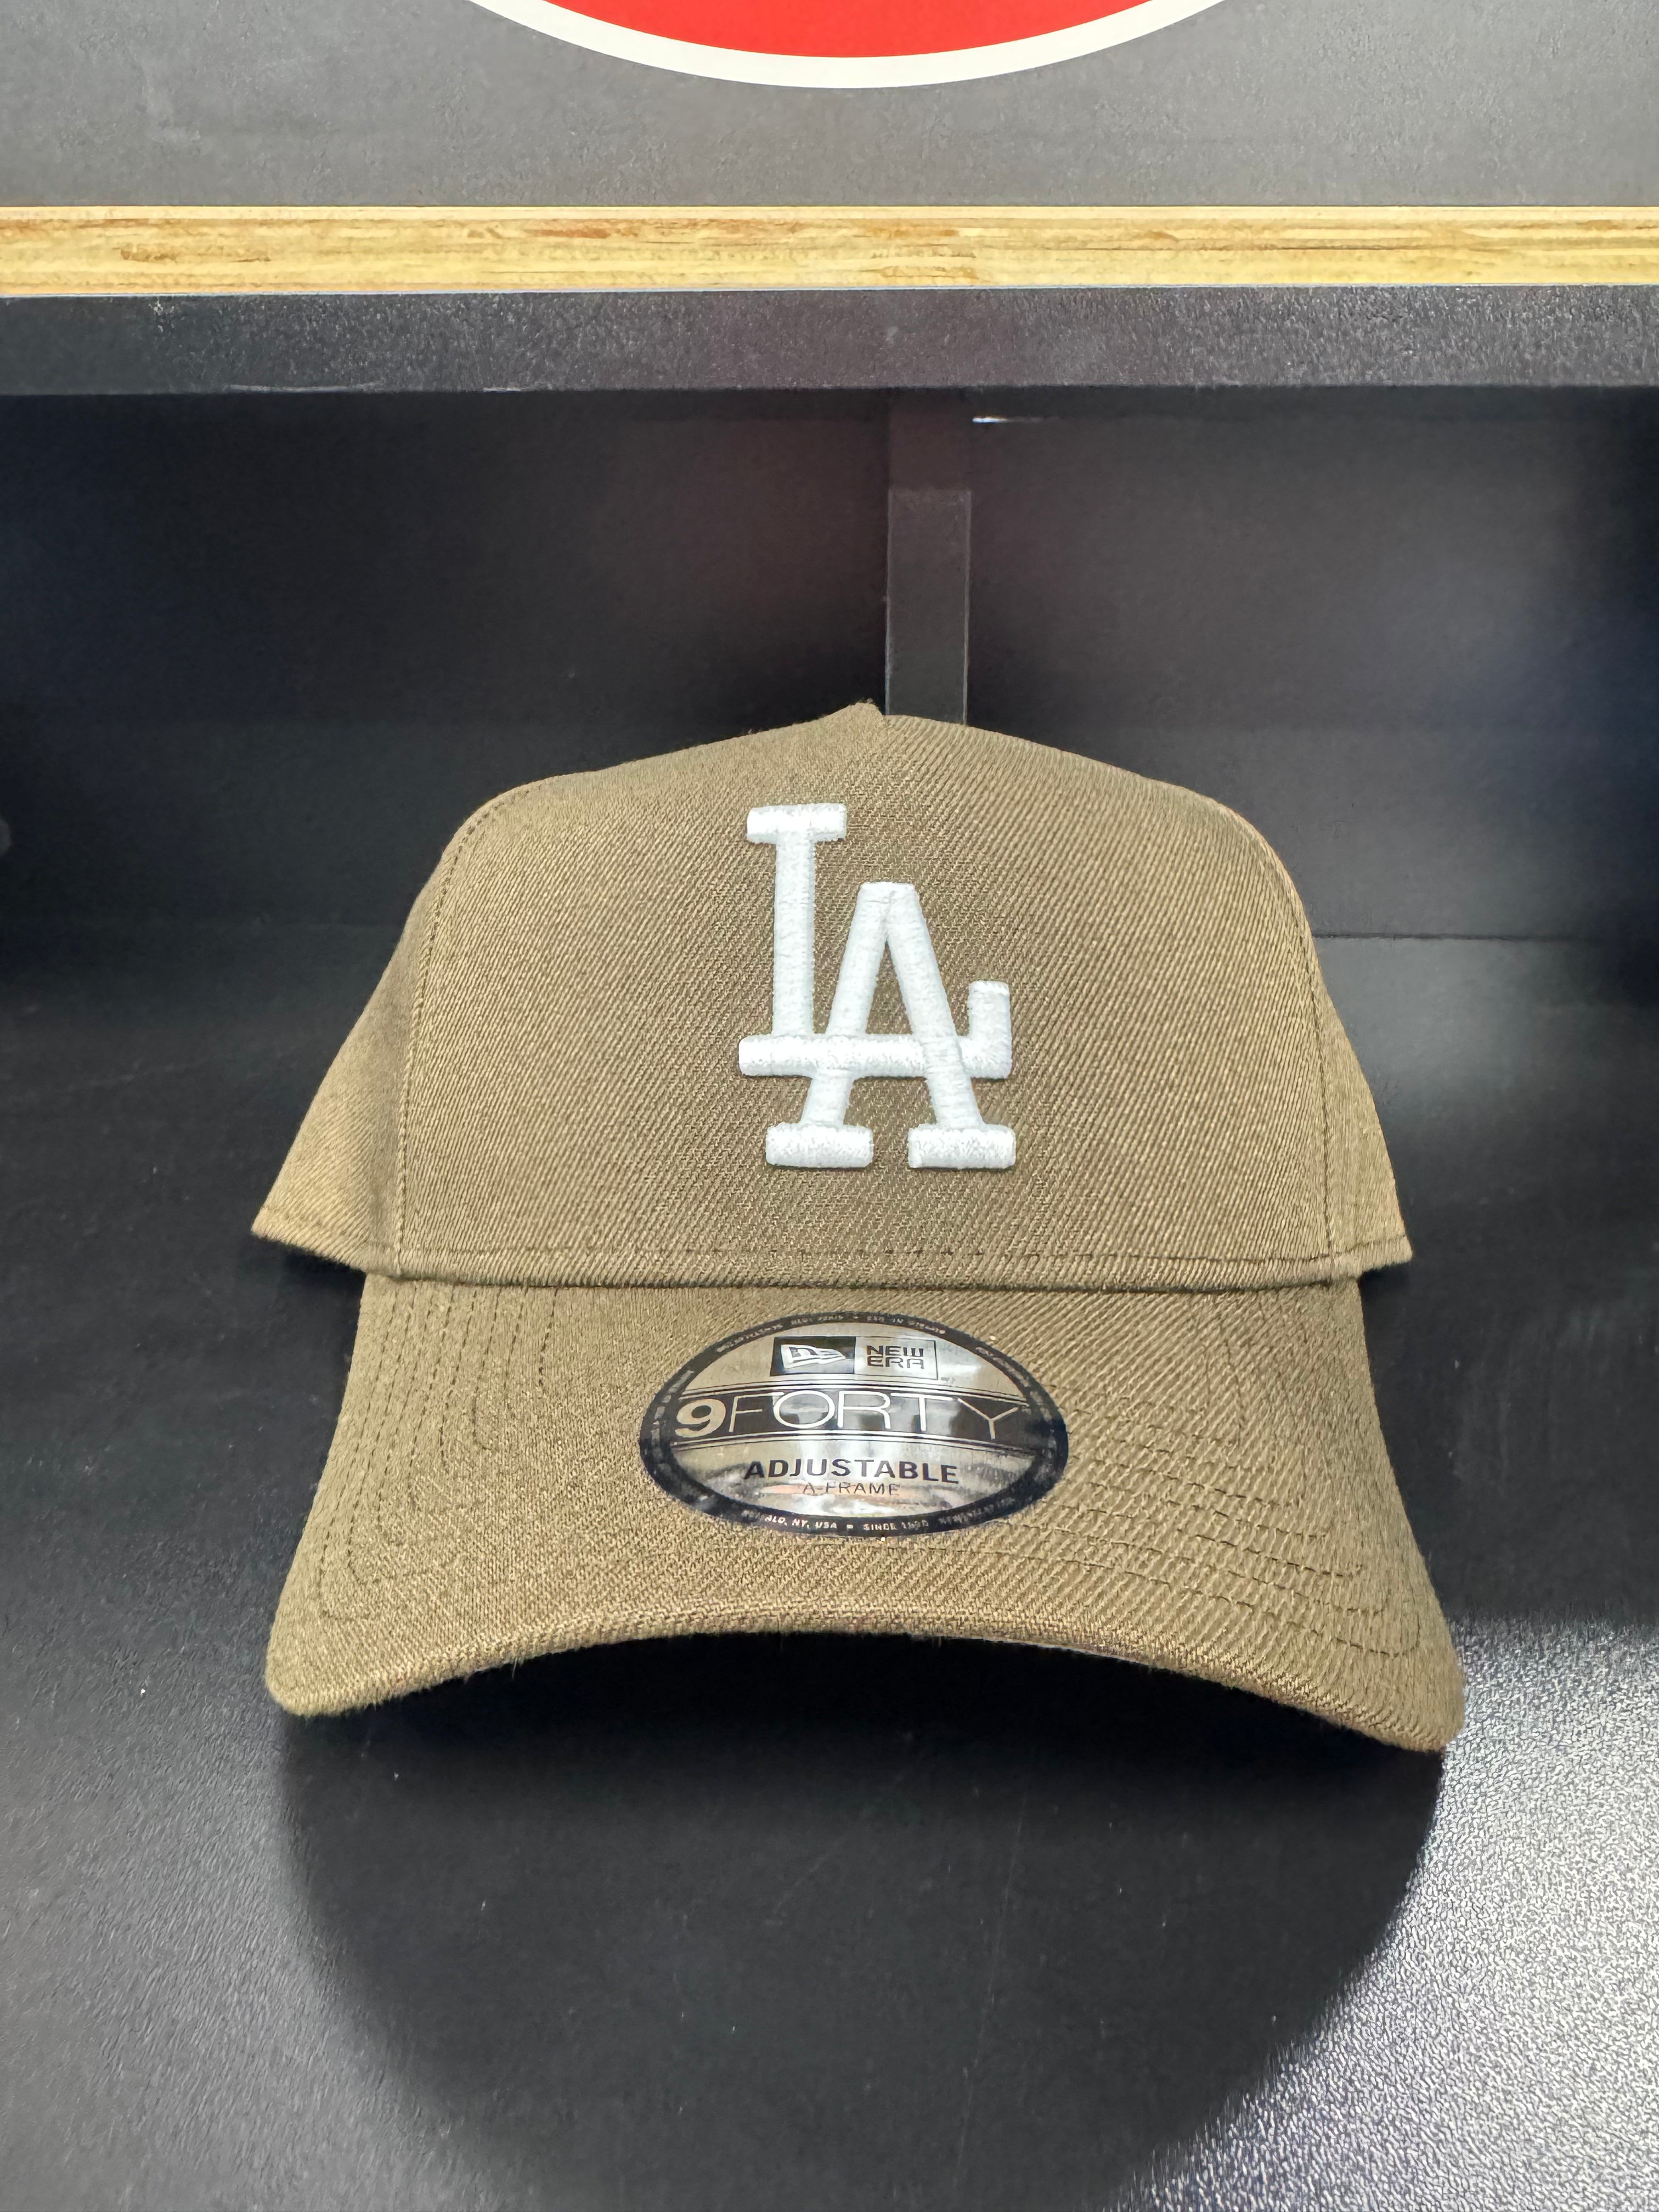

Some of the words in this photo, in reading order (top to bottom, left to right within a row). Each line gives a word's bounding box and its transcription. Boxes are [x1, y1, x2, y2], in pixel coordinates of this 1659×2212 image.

[738, 803, 1017, 1169] LA
[866, 1345, 924, 1357] NEW
[866, 1356, 924, 1369] ERA
[675, 1390, 1019, 1440] 9FORTY
[743, 1458, 959, 1484] ADJUSTABLE
[803, 1482, 900, 1496] A-FRAME
[815, 1521, 838, 1530] USA
